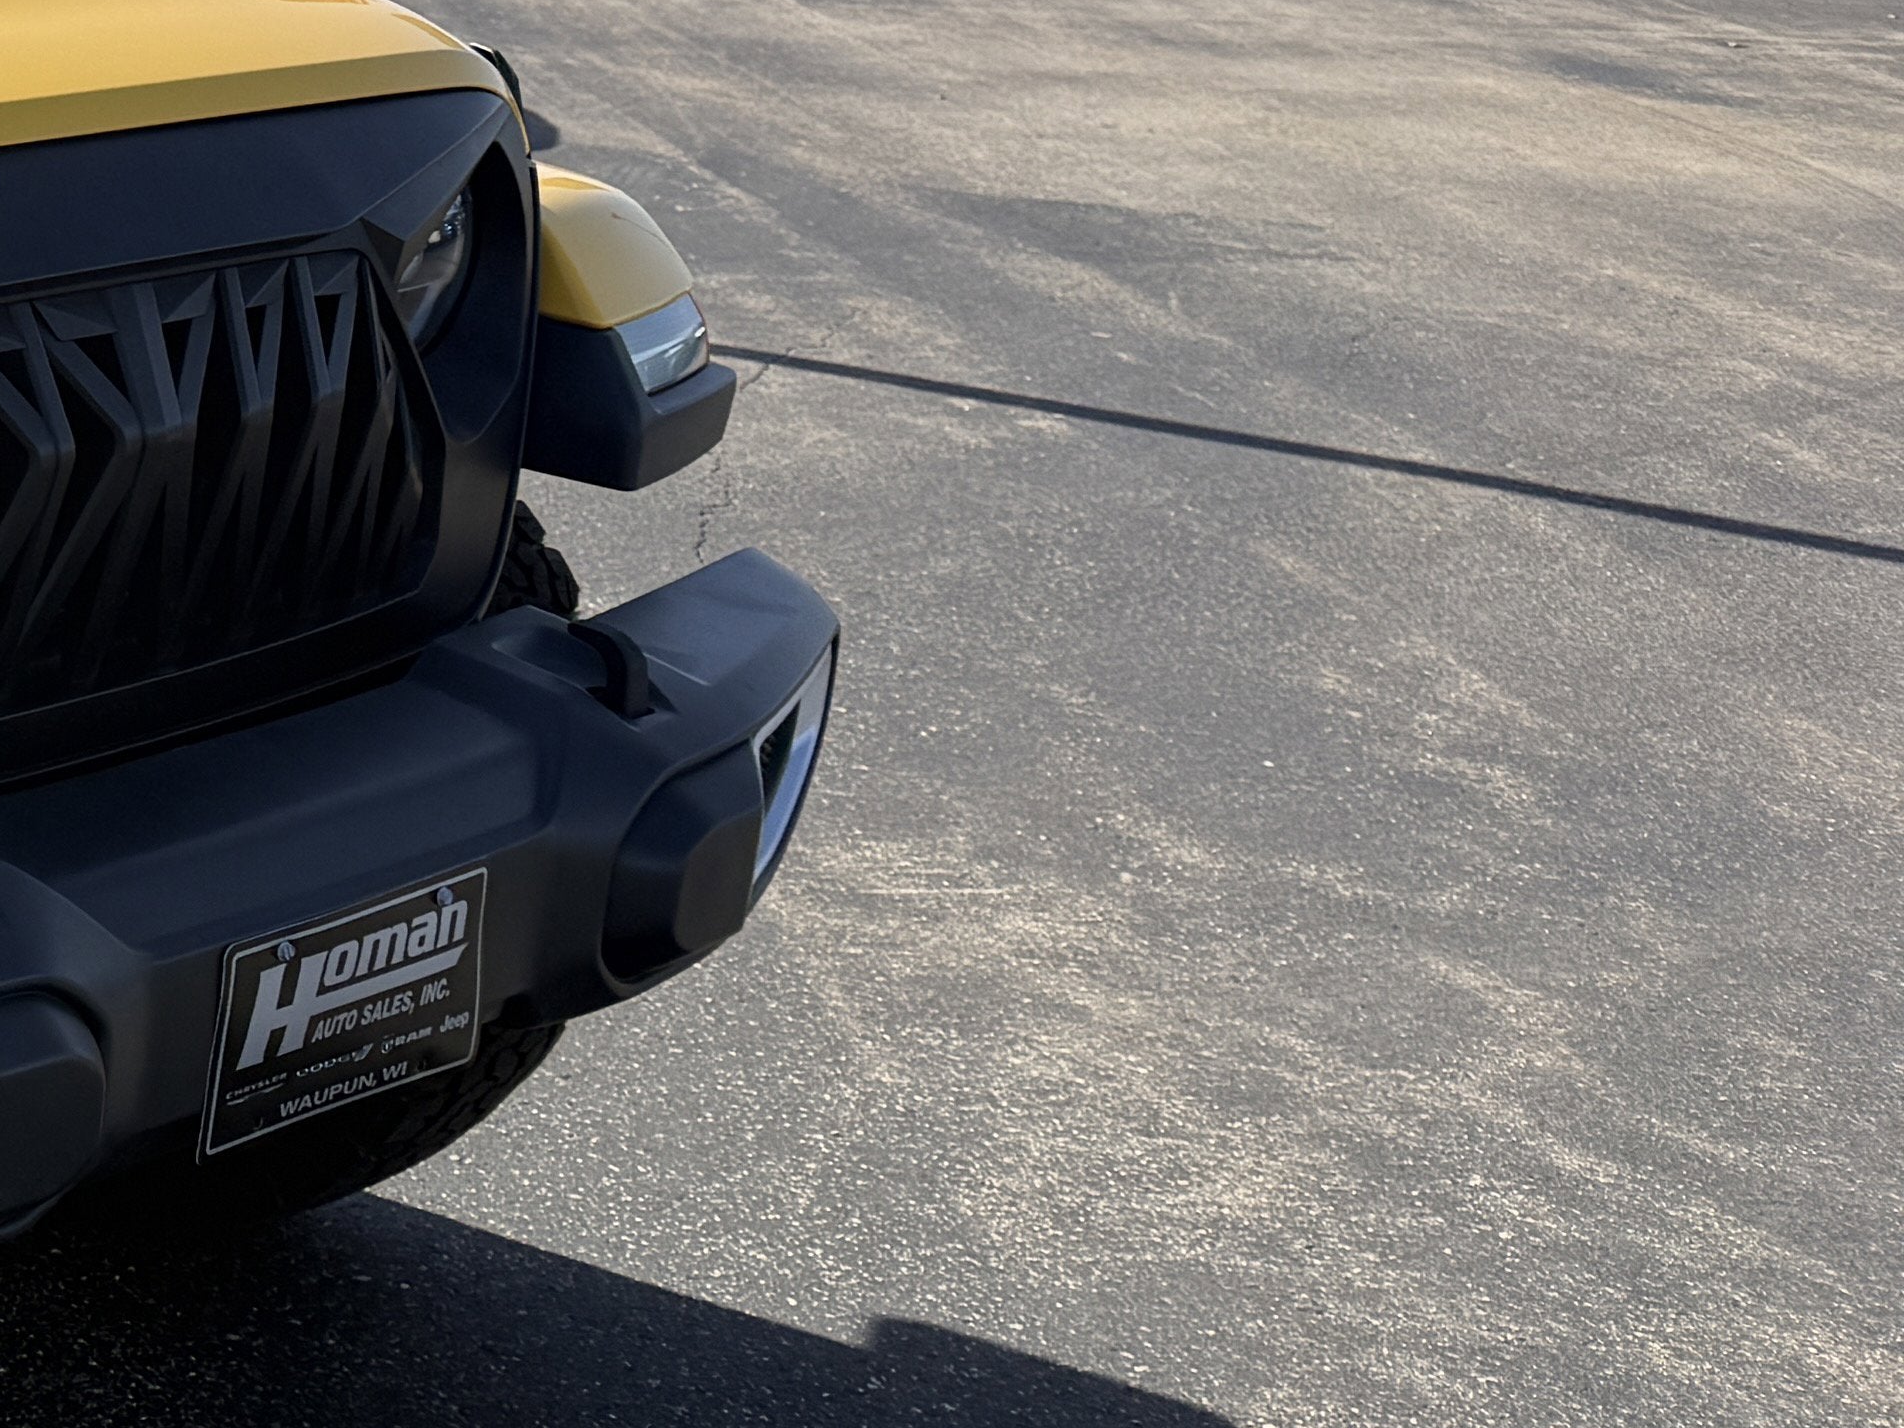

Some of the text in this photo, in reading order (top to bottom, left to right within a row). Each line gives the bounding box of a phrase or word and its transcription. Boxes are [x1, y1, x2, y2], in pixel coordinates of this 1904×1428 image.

[235, 899, 469, 1072] Homan
[310, 978, 452, 1044] AUTO SALES, INC.
[225, 1073, 288, 1101] CHRYSLER
[394, 1026, 434, 1047] RAM
[439, 1011, 470, 1037] Jeep
[279, 1061, 408, 1118] WAUPUN, WI
